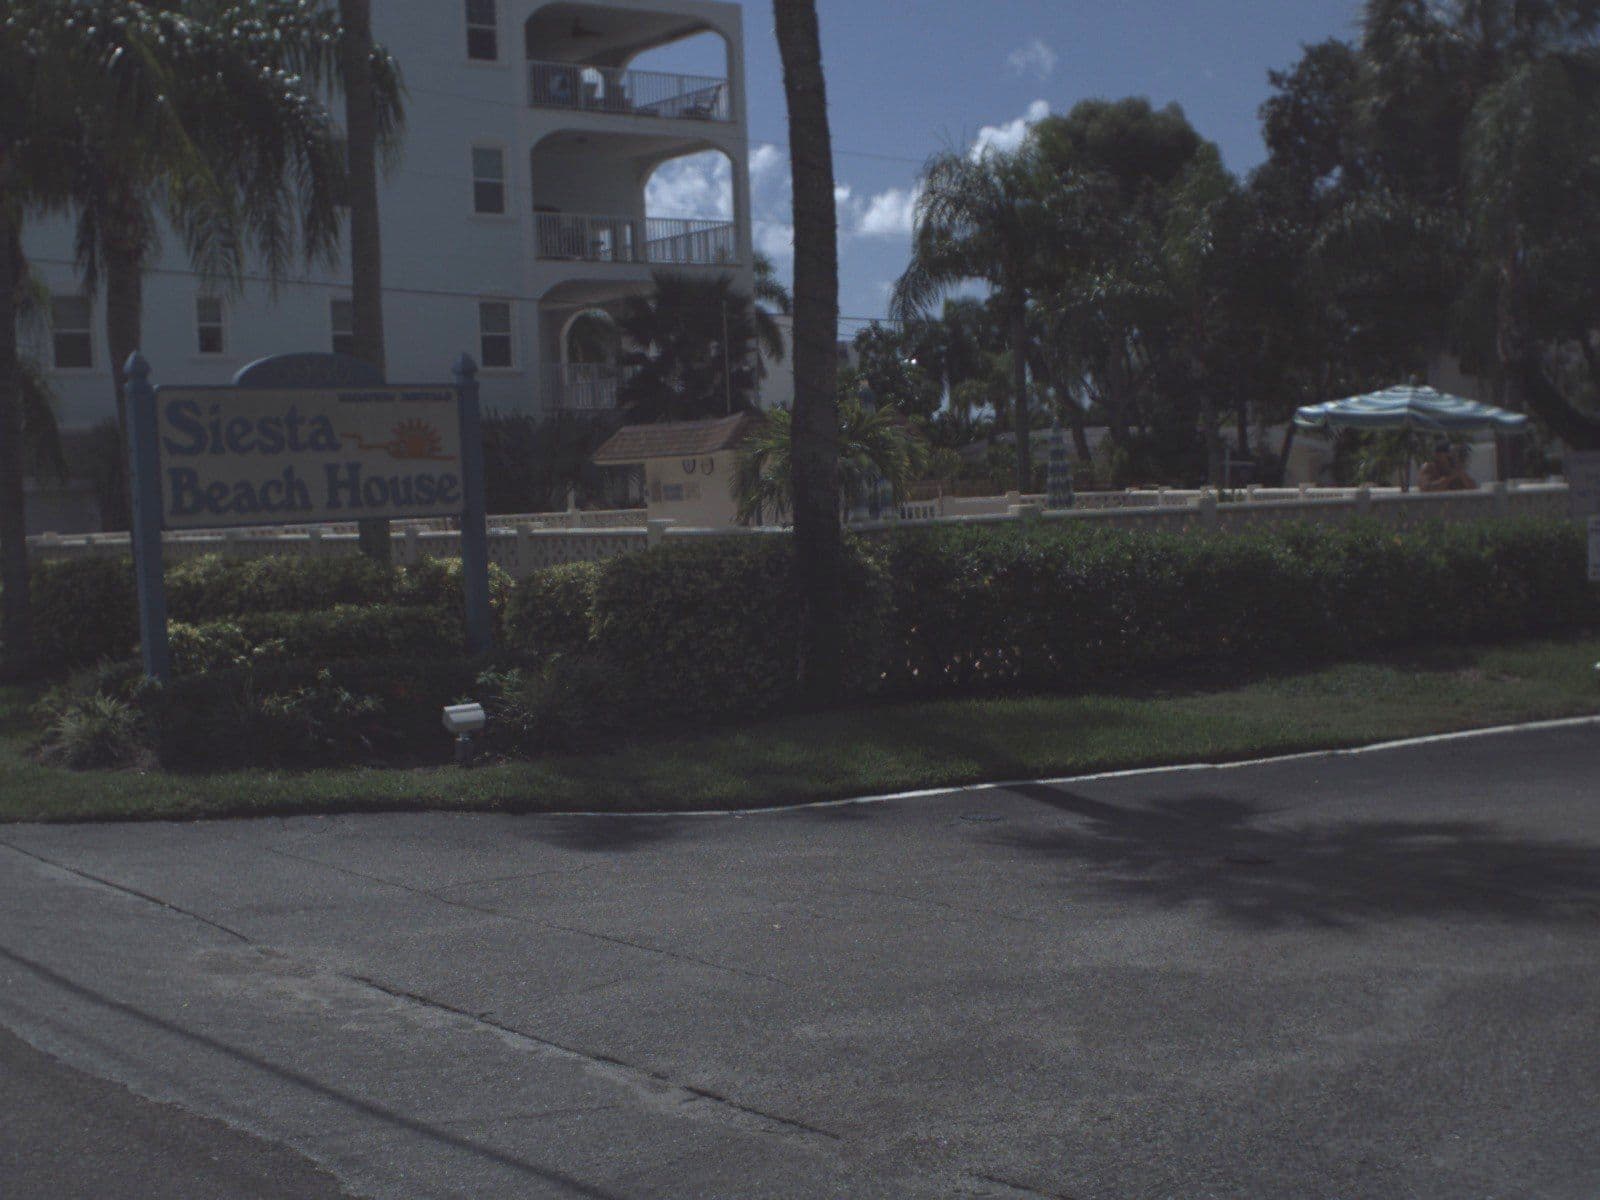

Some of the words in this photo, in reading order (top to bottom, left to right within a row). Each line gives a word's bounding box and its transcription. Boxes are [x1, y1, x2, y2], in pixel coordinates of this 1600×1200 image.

[163, 399, 342, 456] Siesta
[167, 465, 313, 515] Beach
[323, 461, 461, 509] House
